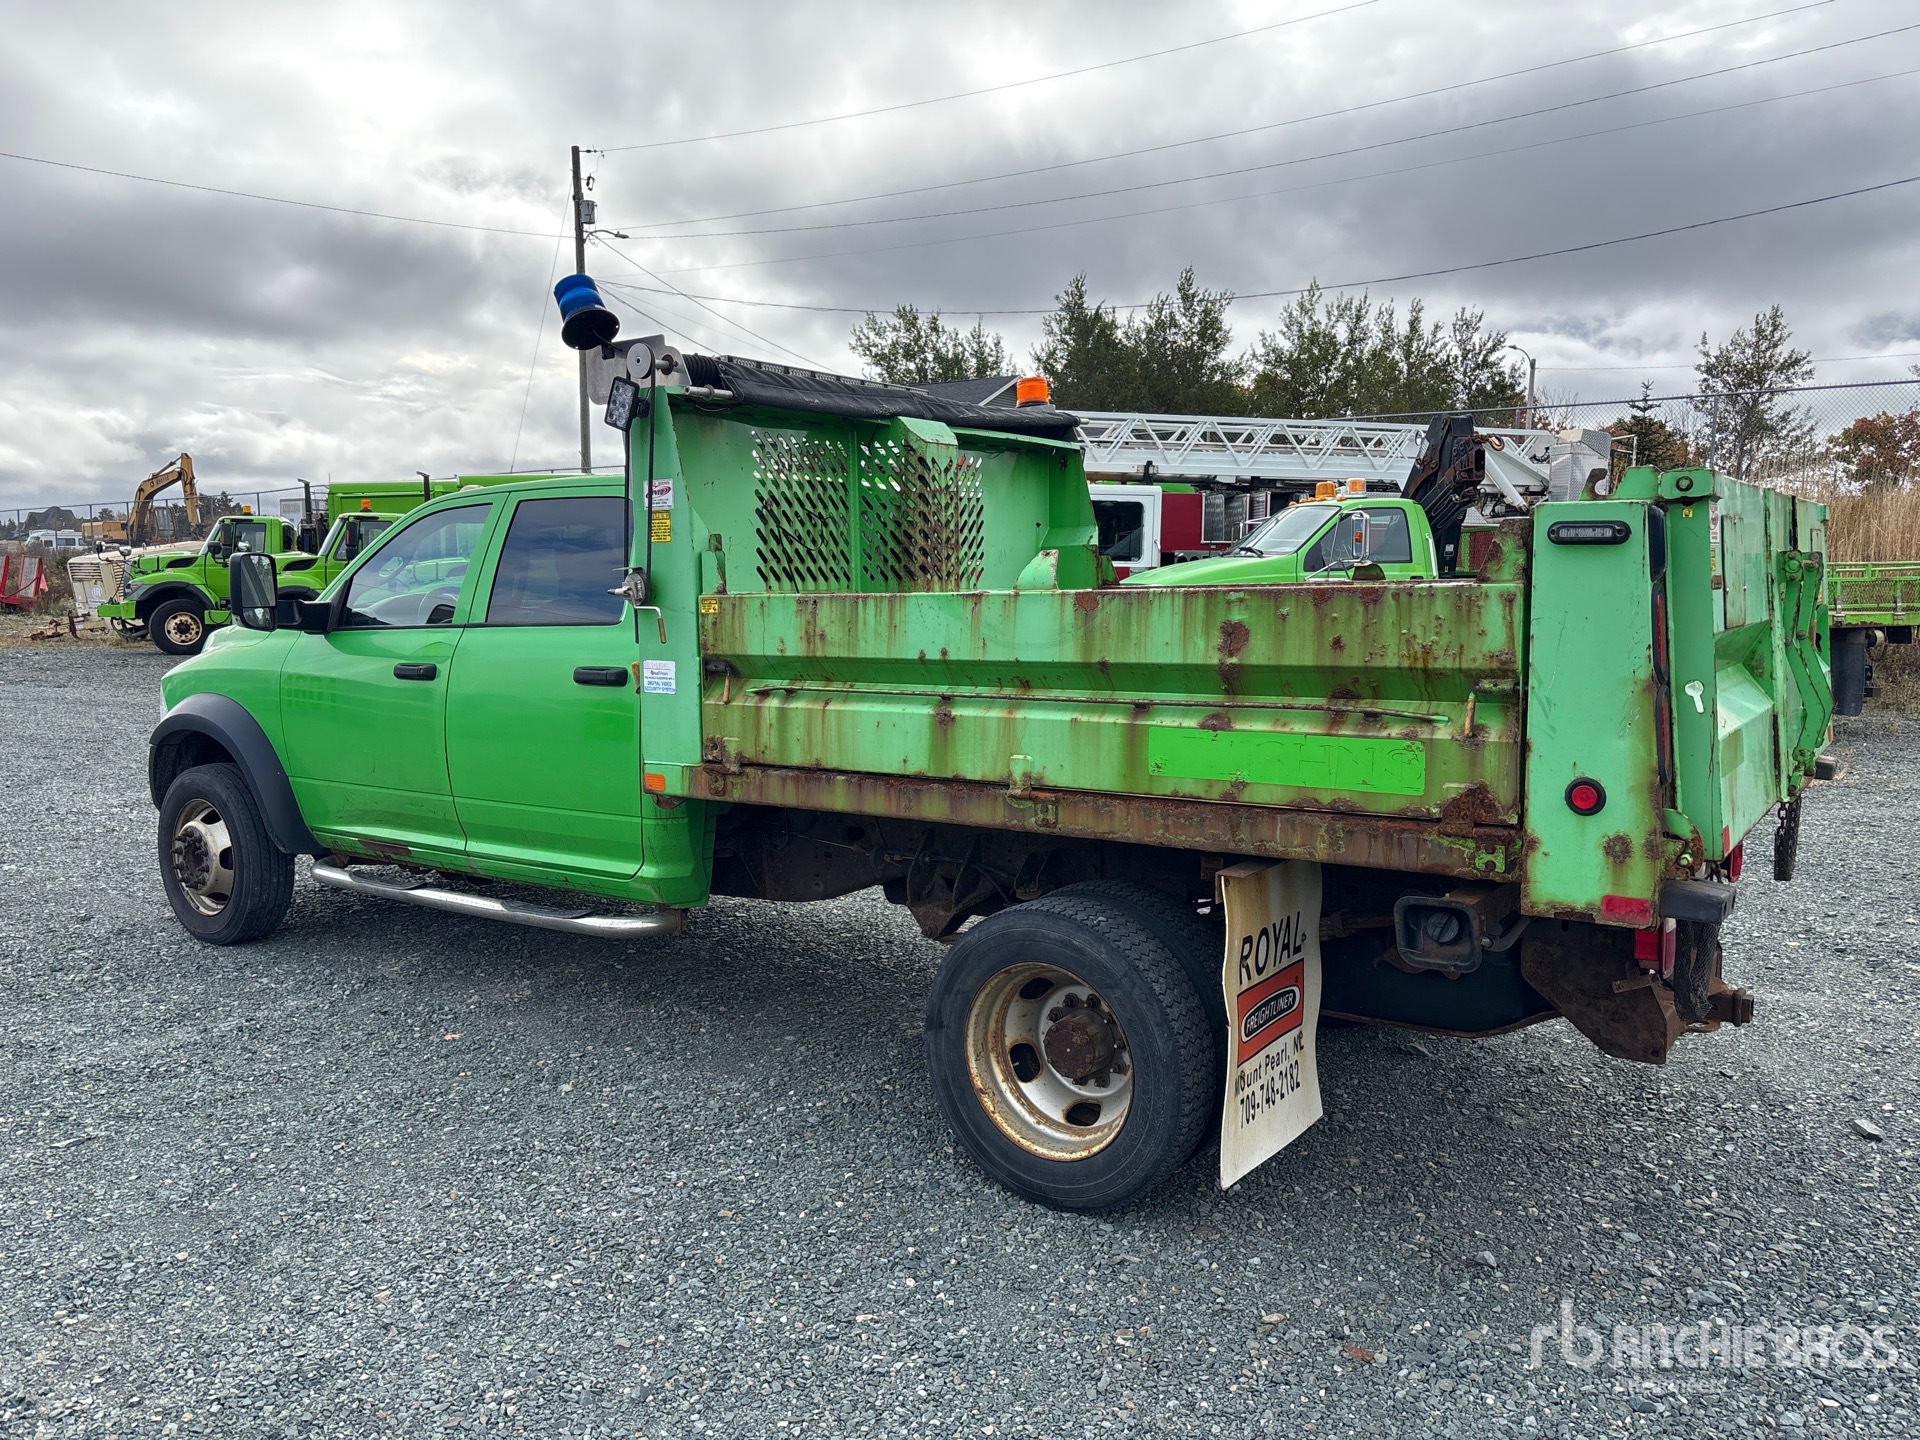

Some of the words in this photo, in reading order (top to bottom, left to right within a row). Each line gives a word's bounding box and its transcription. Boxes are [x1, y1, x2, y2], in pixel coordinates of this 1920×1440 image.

[1239, 911, 1302, 986] ROYAL
[1246, 993, 1295, 1034] FREIGHTLINER
[1240, 1059, 1300, 1129] 709-748-2182
